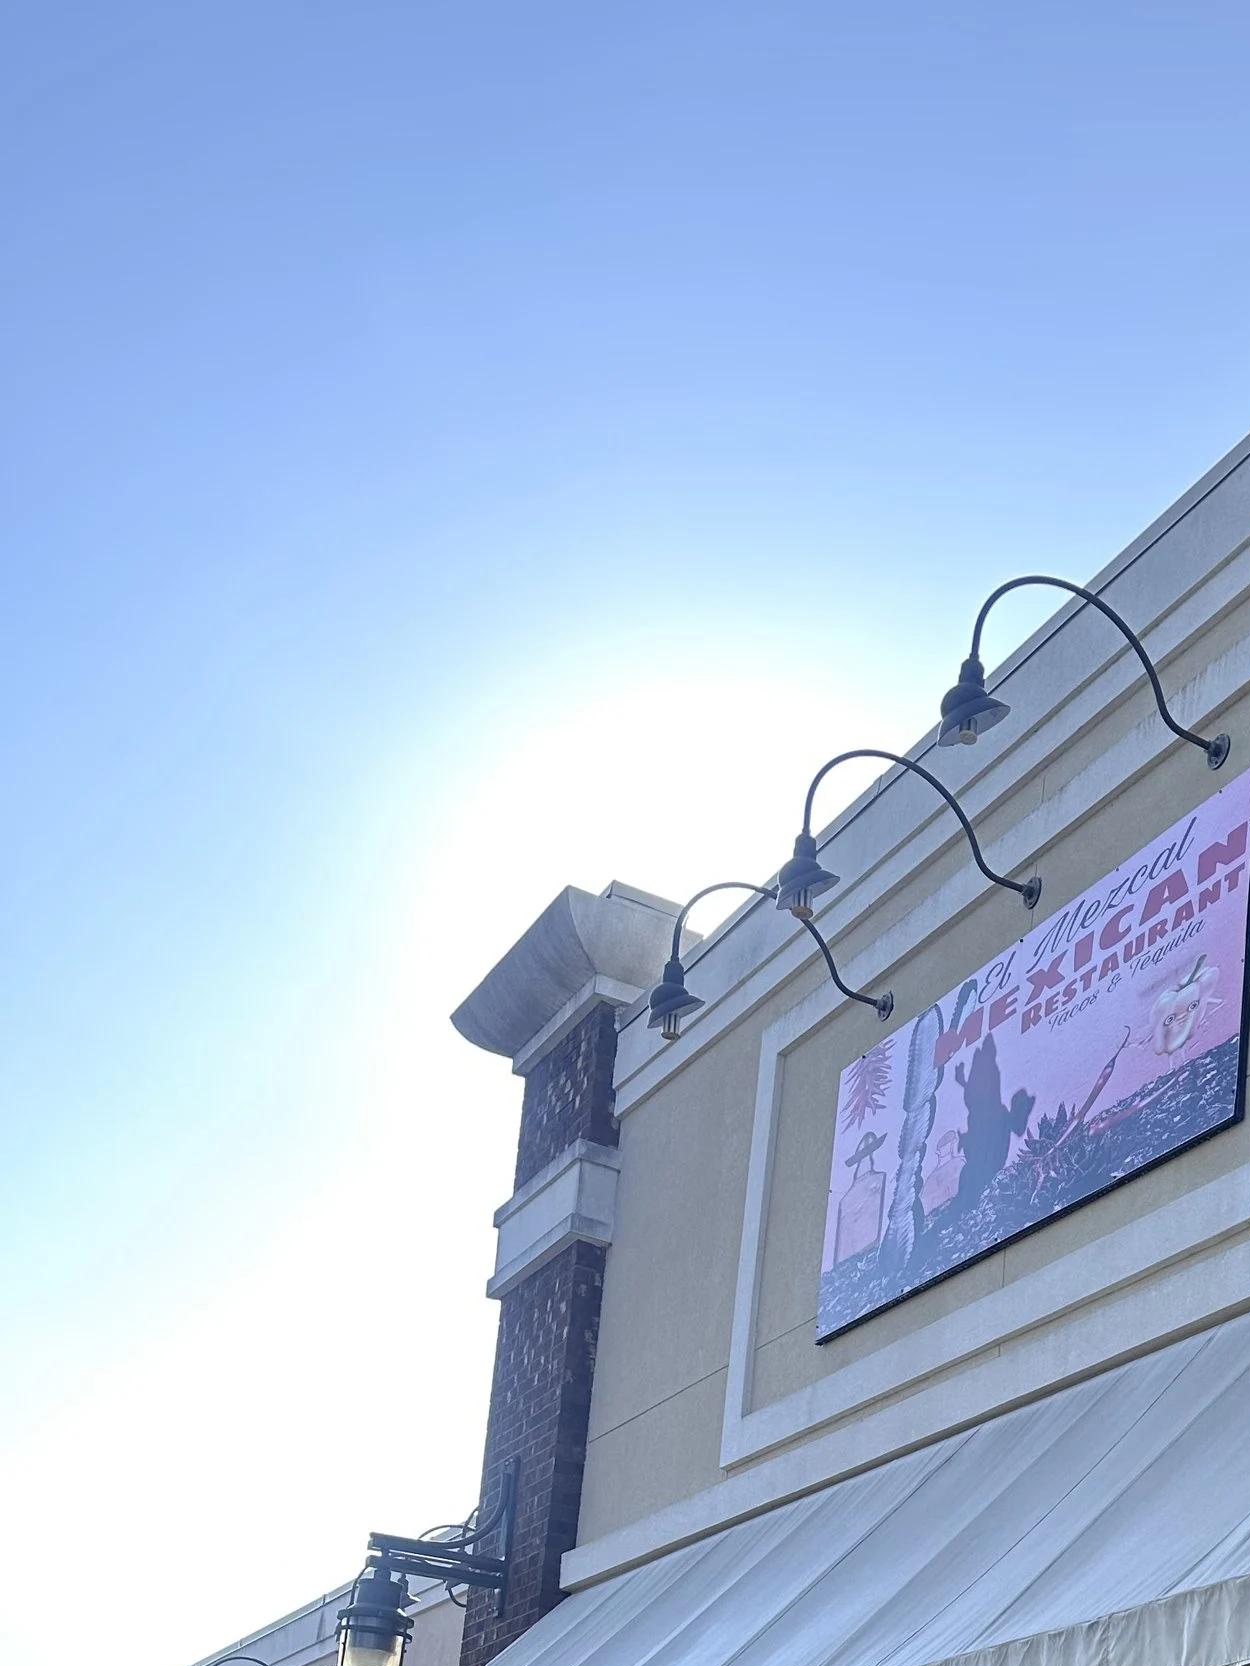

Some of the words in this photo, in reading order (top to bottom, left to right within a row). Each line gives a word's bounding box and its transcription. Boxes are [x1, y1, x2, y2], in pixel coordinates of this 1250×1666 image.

[933, 821, 1248, 1068] MEXICAN
[978, 951, 1016, 1004] El
[1027, 816, 1198, 974] Mezcal
[1021, 862, 1245, 1035] RESTAURANT
[1048, 989, 1100, 1032] Tacos
[1107, 973, 1122, 993] &
[1129, 919, 1205, 978] Tequila
